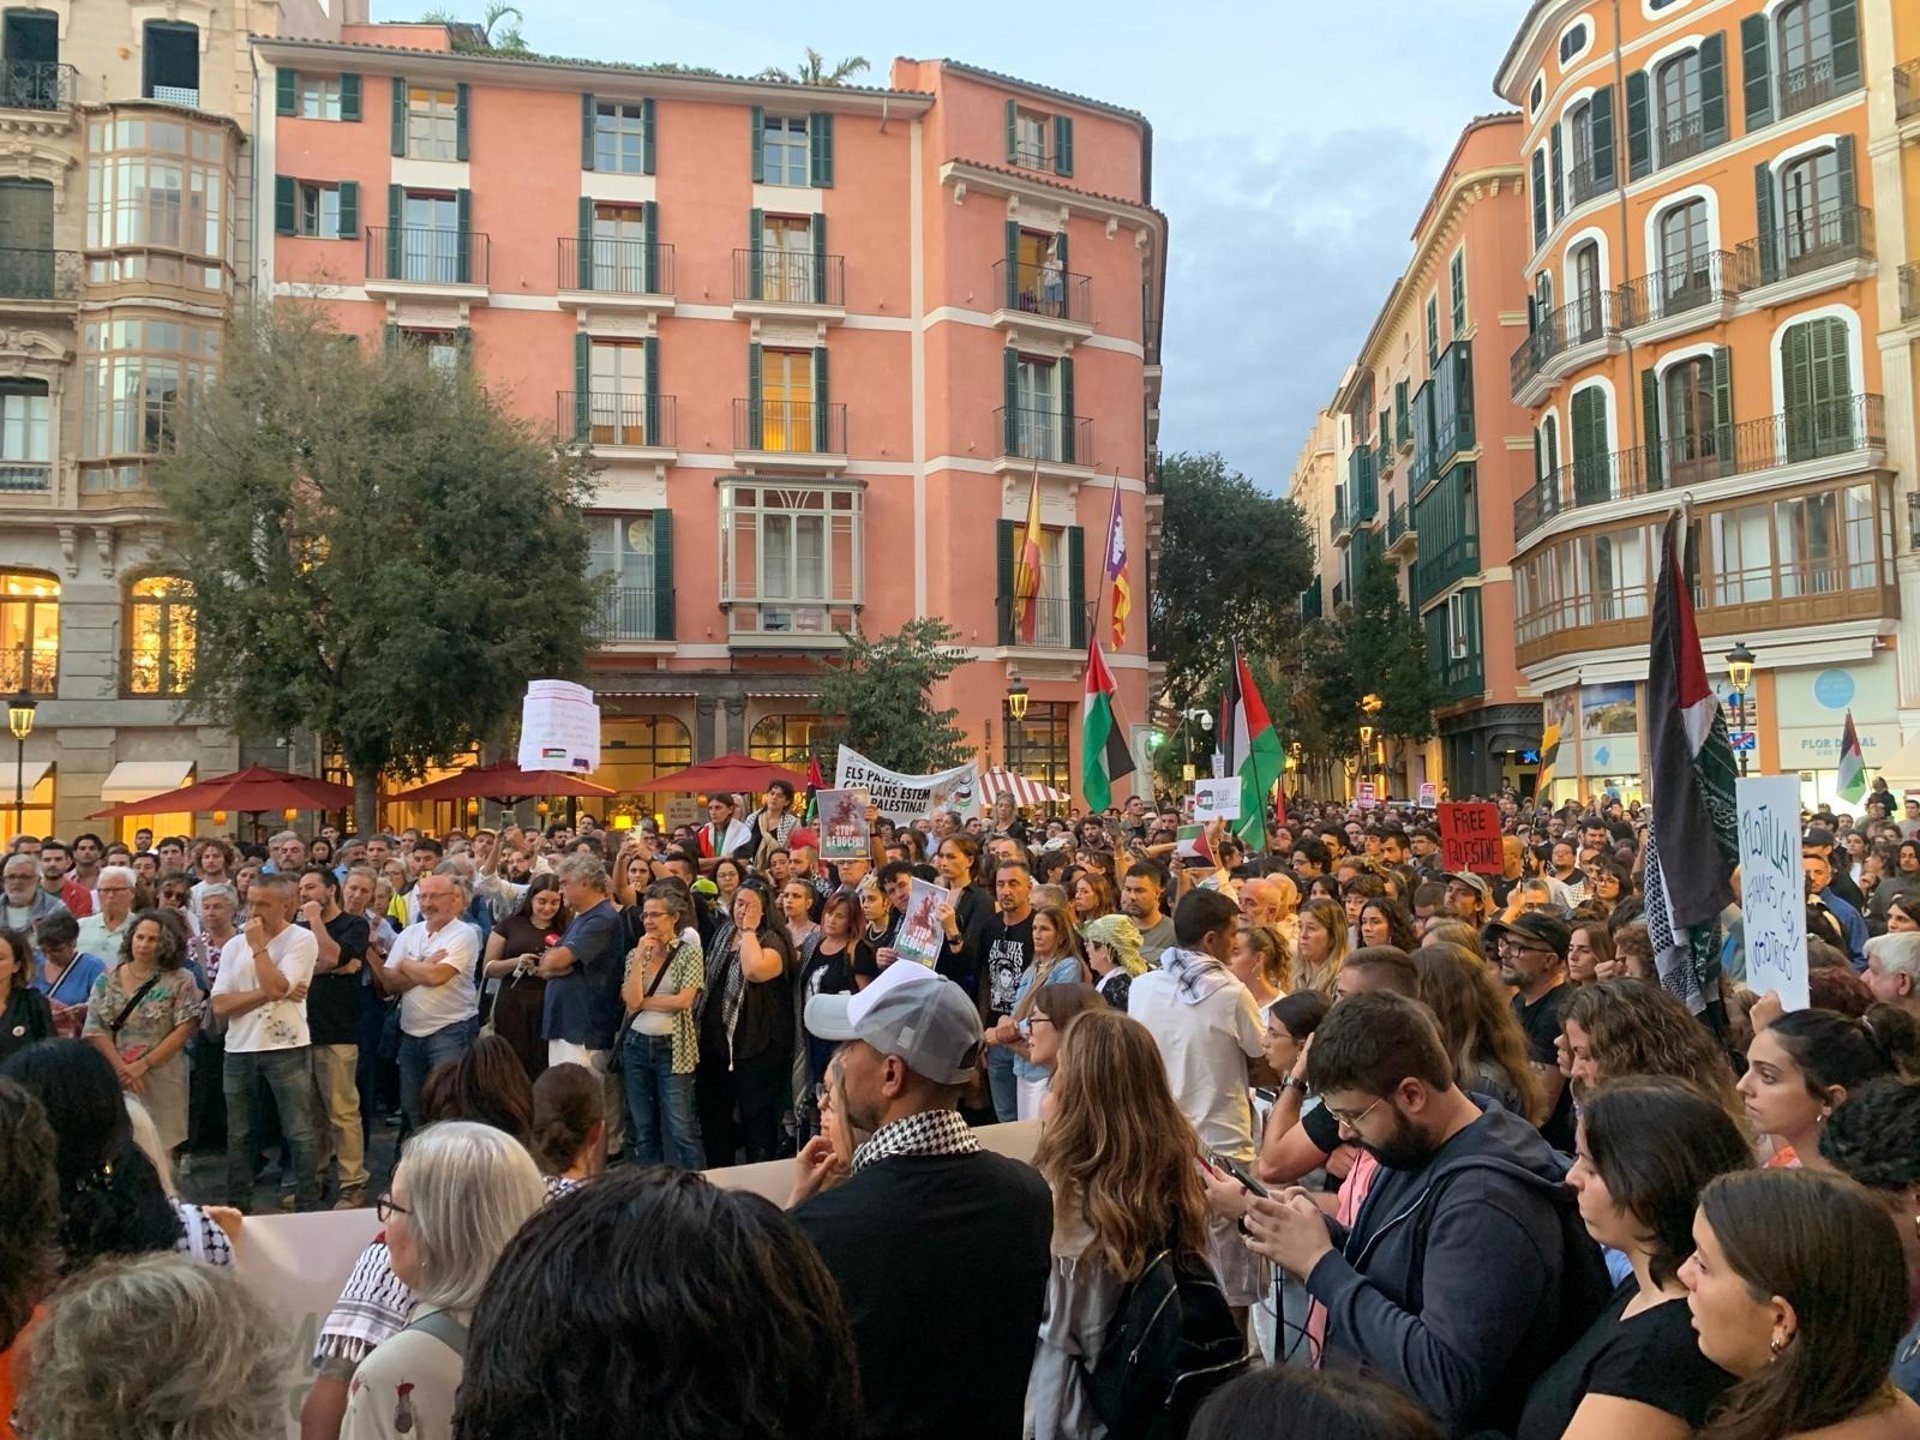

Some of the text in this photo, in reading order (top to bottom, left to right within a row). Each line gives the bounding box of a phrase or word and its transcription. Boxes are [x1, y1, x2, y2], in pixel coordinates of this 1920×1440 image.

[1801, 739, 1831, 749] FLOR
[1860, 737, 1877, 747] AL
[845, 766, 864, 780] ELS
[900, 787, 931, 800] ESTEM
[870, 797, 927, 813] PALESTINA!
[1452, 808, 1486, 834] FREE
[835, 825, 855, 836] STOP
